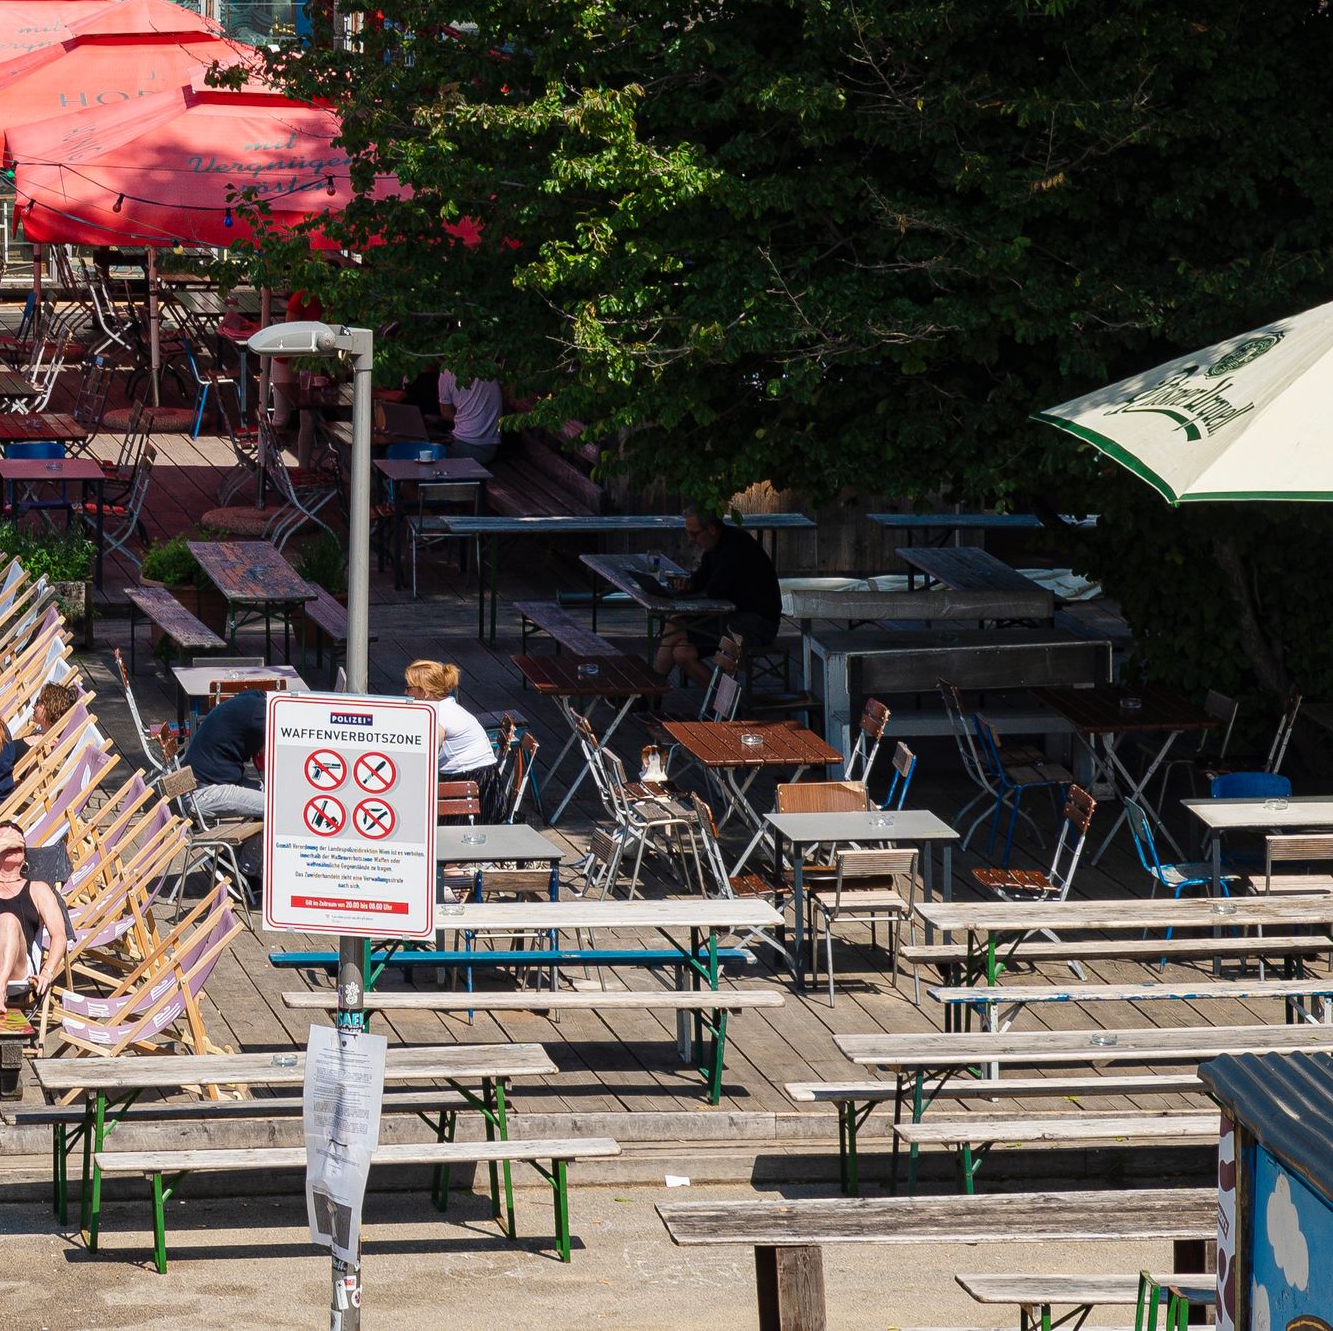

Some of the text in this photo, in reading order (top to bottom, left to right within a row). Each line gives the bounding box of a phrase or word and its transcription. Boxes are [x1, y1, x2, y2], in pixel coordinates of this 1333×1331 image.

[245, 133, 297, 150] mit
[331, 715, 367, 725] POLIZEI
[281, 727, 422, 745] WAFFENVERBOTSZONE
[293, 844, 318, 852] Verordnung
